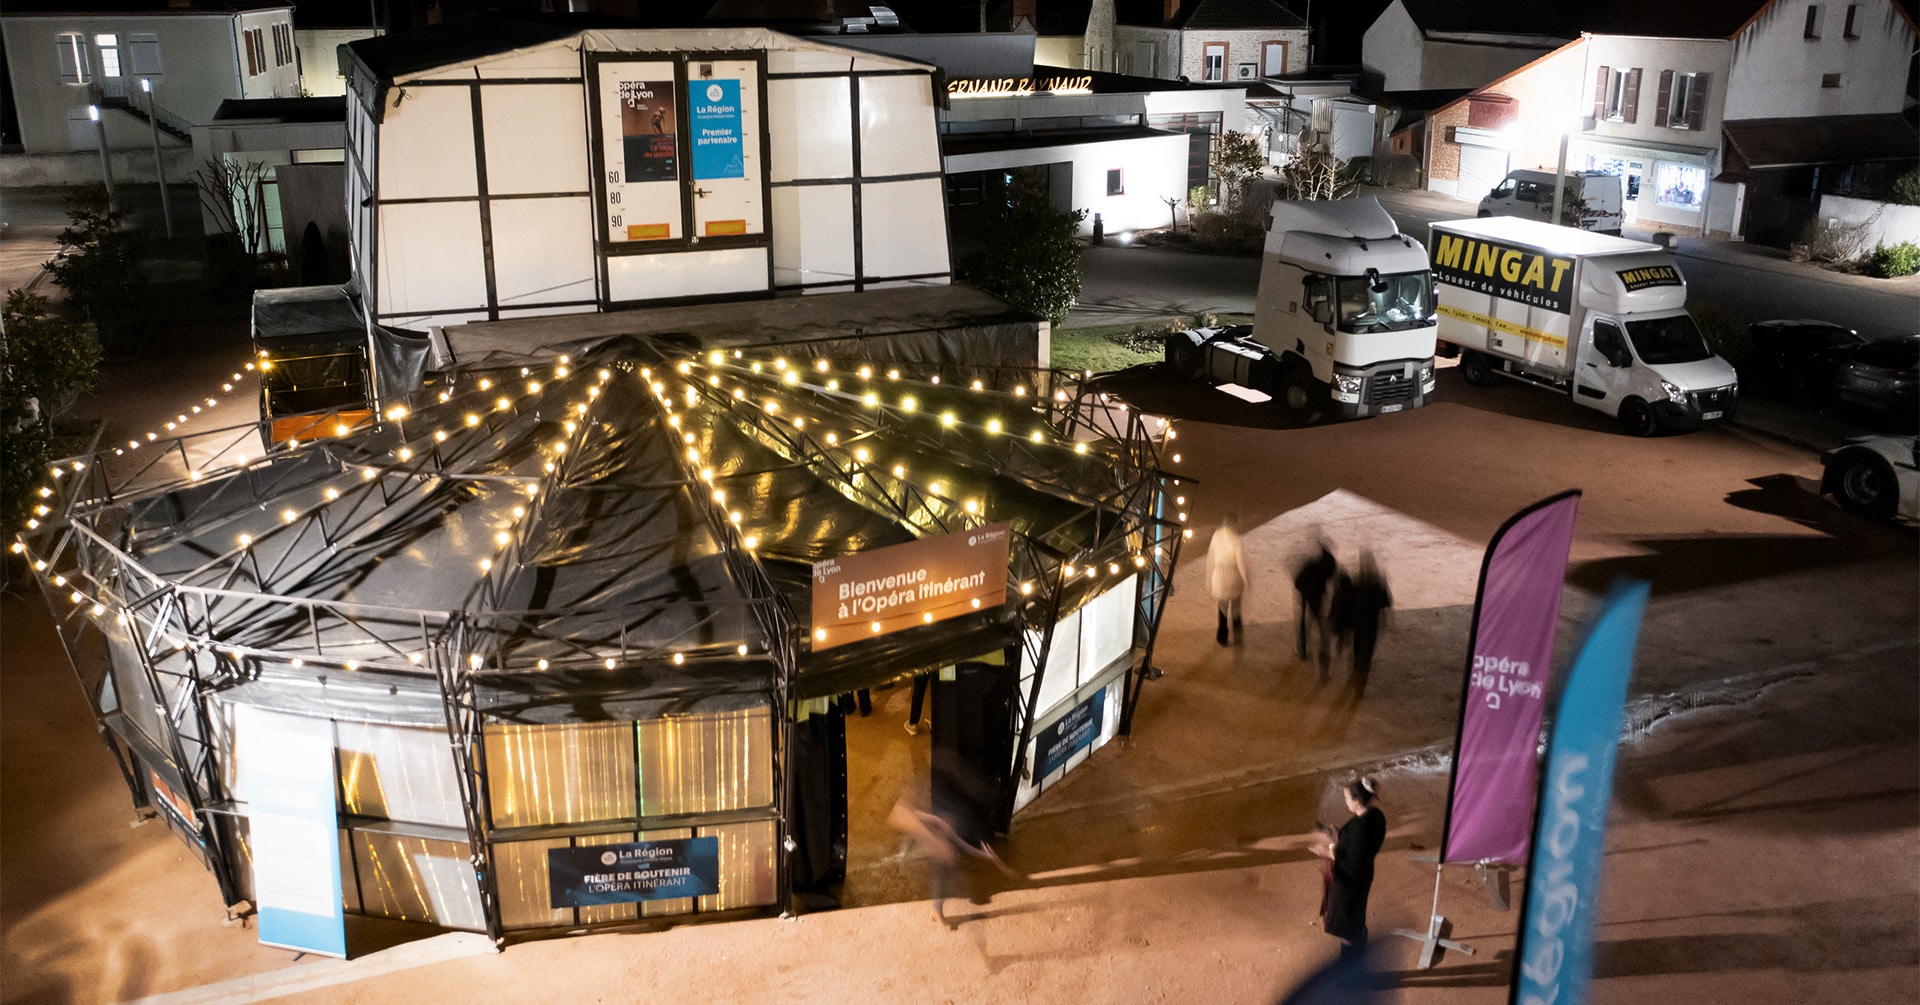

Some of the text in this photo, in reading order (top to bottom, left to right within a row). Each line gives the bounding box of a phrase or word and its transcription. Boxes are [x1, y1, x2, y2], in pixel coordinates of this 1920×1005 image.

[619, 81, 646, 91] opéra
[946, 76, 1093, 94] ERNAND RAYNAUD
[619, 89, 654, 100] de Lyon
[696, 104, 735, 115] La Région
[702, 128, 733, 136] Premier
[697, 136, 738, 147] partenaire
[608, 170, 620, 184] 60
[610, 191, 621, 204] 80
[611, 214, 623, 228] 90
[1435, 234, 1571, 293] MINGAT
[1621, 267, 1674, 284] MINGAT
[1438, 271, 1560, 309] Loueur de véhicules
[838, 568, 927, 601] Bienvenue
[838, 602, 849, 619] à
[852, 588, 916, 615] l'Opéra
[1473, 655, 1531, 678] opéra
[1471, 670, 1543, 700] de Lyon
[618, 847, 673, 859] La Région
[583, 867, 691, 884] FIÈRE DE SOUTENIR
[588, 876, 687, 894] L'OPÉRA ITINÉRANT
